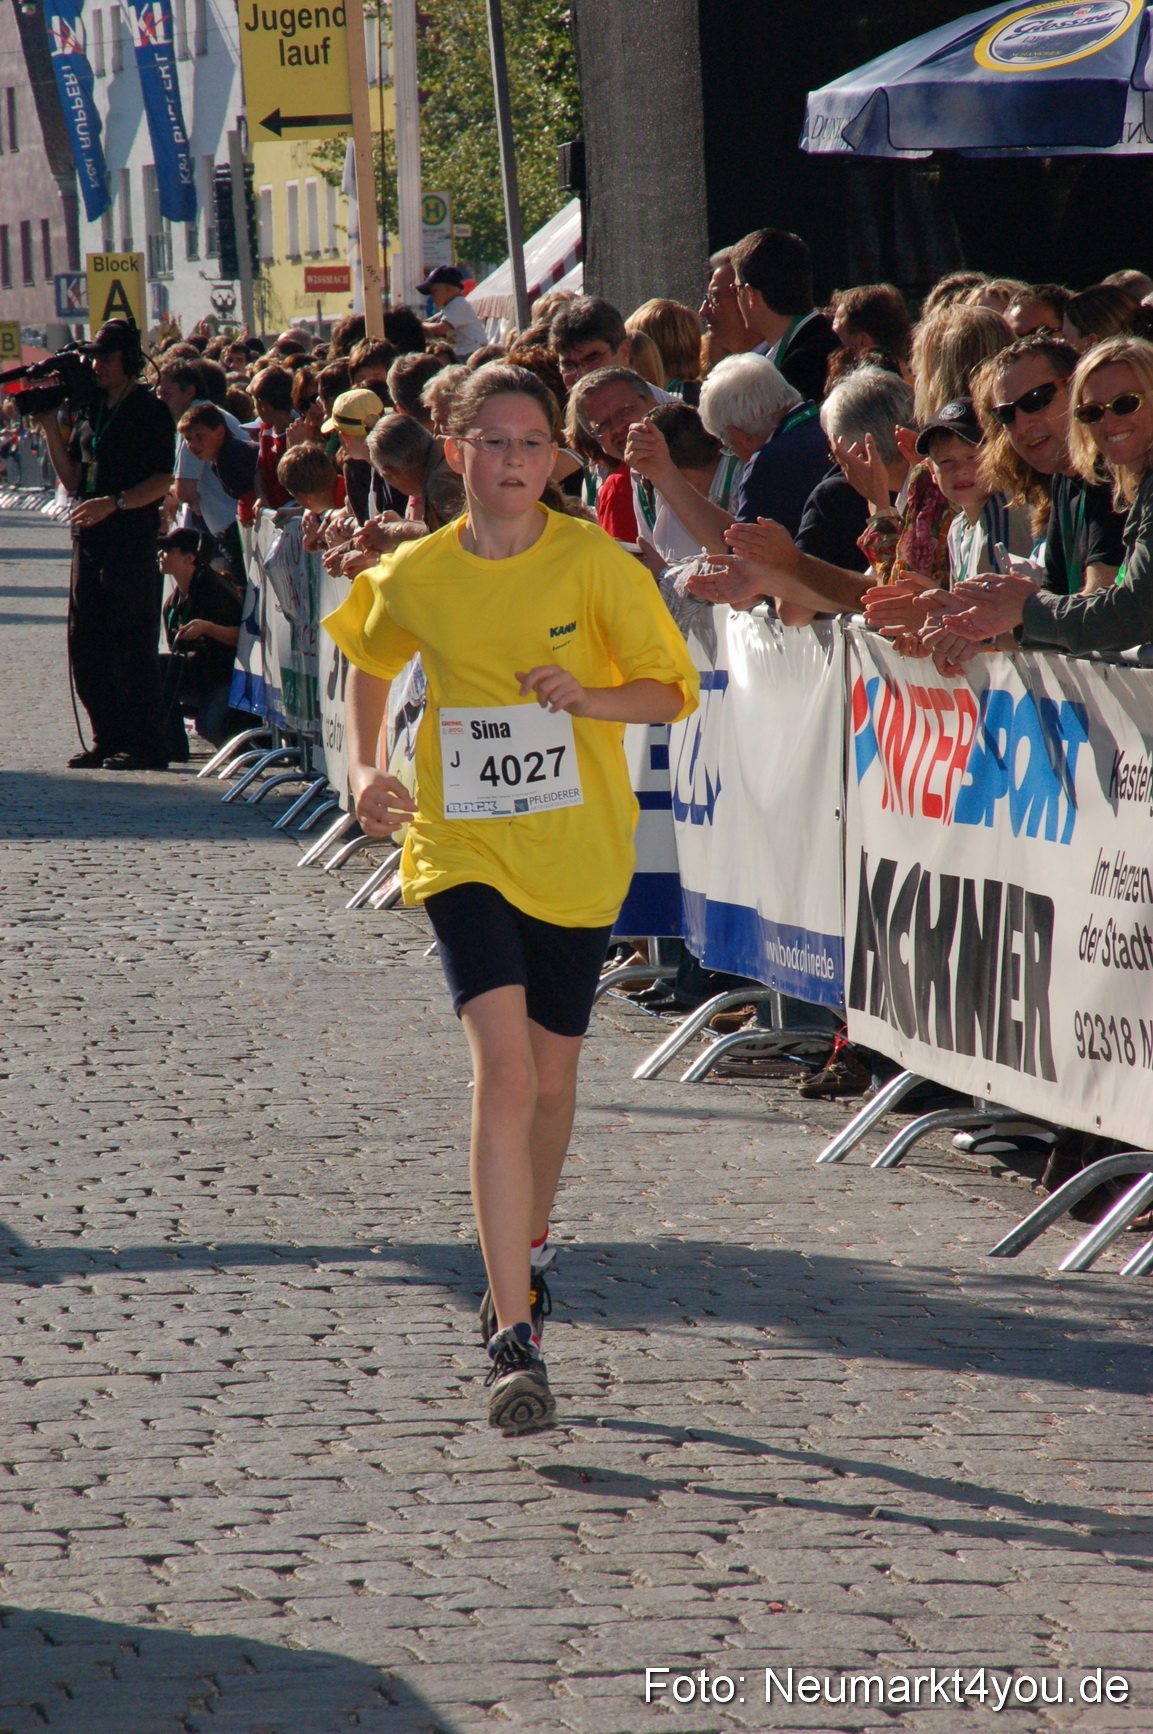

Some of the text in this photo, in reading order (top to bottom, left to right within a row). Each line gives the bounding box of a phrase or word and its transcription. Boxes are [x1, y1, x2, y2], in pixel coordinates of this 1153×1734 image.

[245, 0, 346, 37] Jugend
[1003, 9, 1124, 41] Glossner
[279, 36, 330, 66] lauf
[93, 256, 138, 272] Block
[102, 279, 135, 322] A
[2, 333, 14, 351] B
[470, 719, 511, 740] Sina
[450, 750, 460, 768] J
[479, 745, 566, 787] 4027
[876, 682, 1089, 845] INTERSPORT
[529, 788, 580, 805] PFLEIDERER
[1108, 749, 1153, 818] Kasten
[447, 801, 498, 813] BOCK
[1090, 847, 1153, 904] Im Herzen
[1078, 913, 1103, 964] der
[1074, 1010, 1137, 1067] 92318
